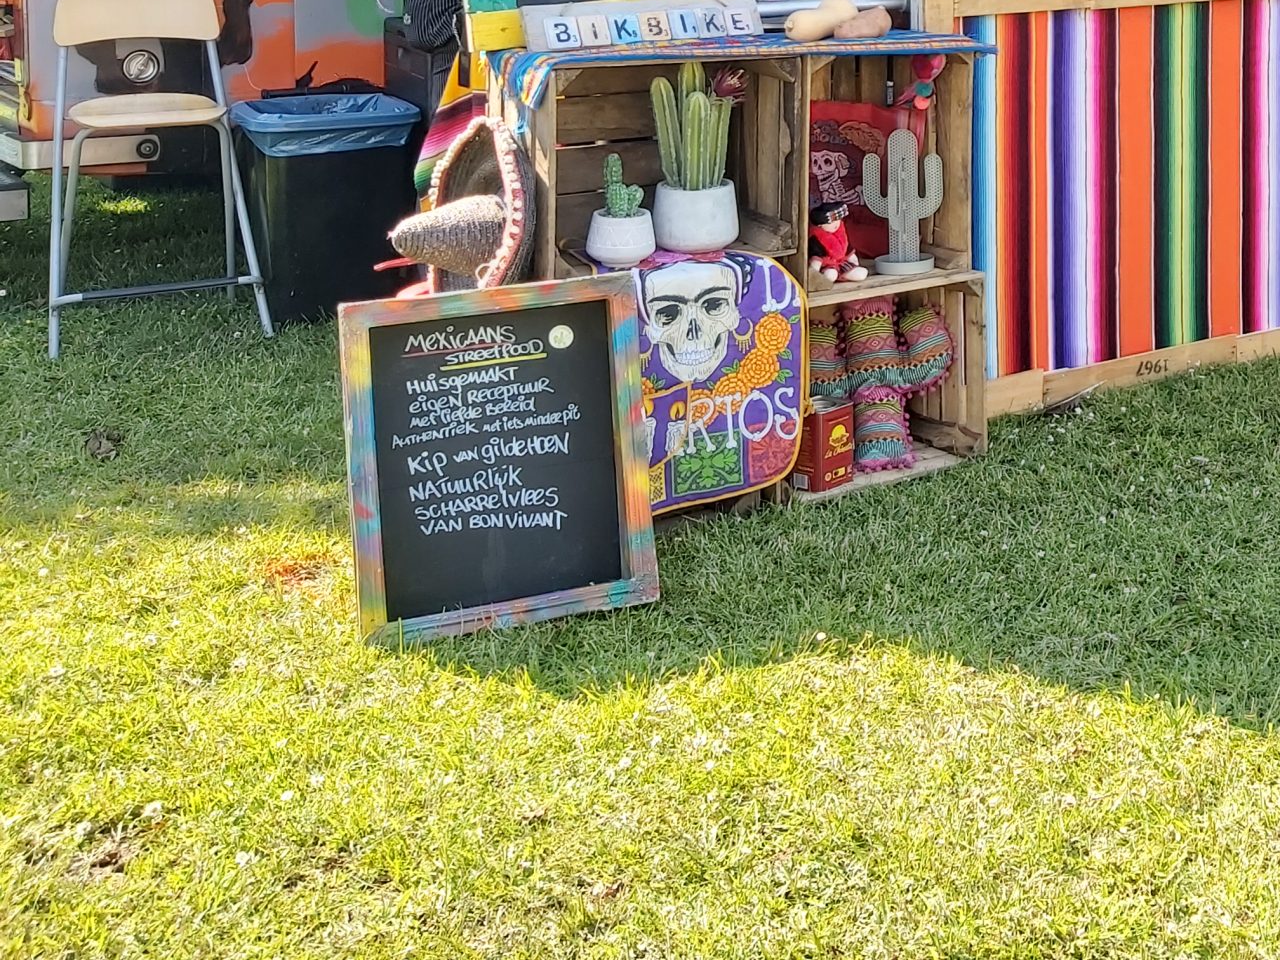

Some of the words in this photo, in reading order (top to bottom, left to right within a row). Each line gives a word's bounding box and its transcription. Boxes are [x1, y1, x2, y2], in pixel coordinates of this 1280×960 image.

[1136, 358, 1169, 378] 1967
[407, 451, 448, 476] Kip
[420, 516, 463, 536] VAN
